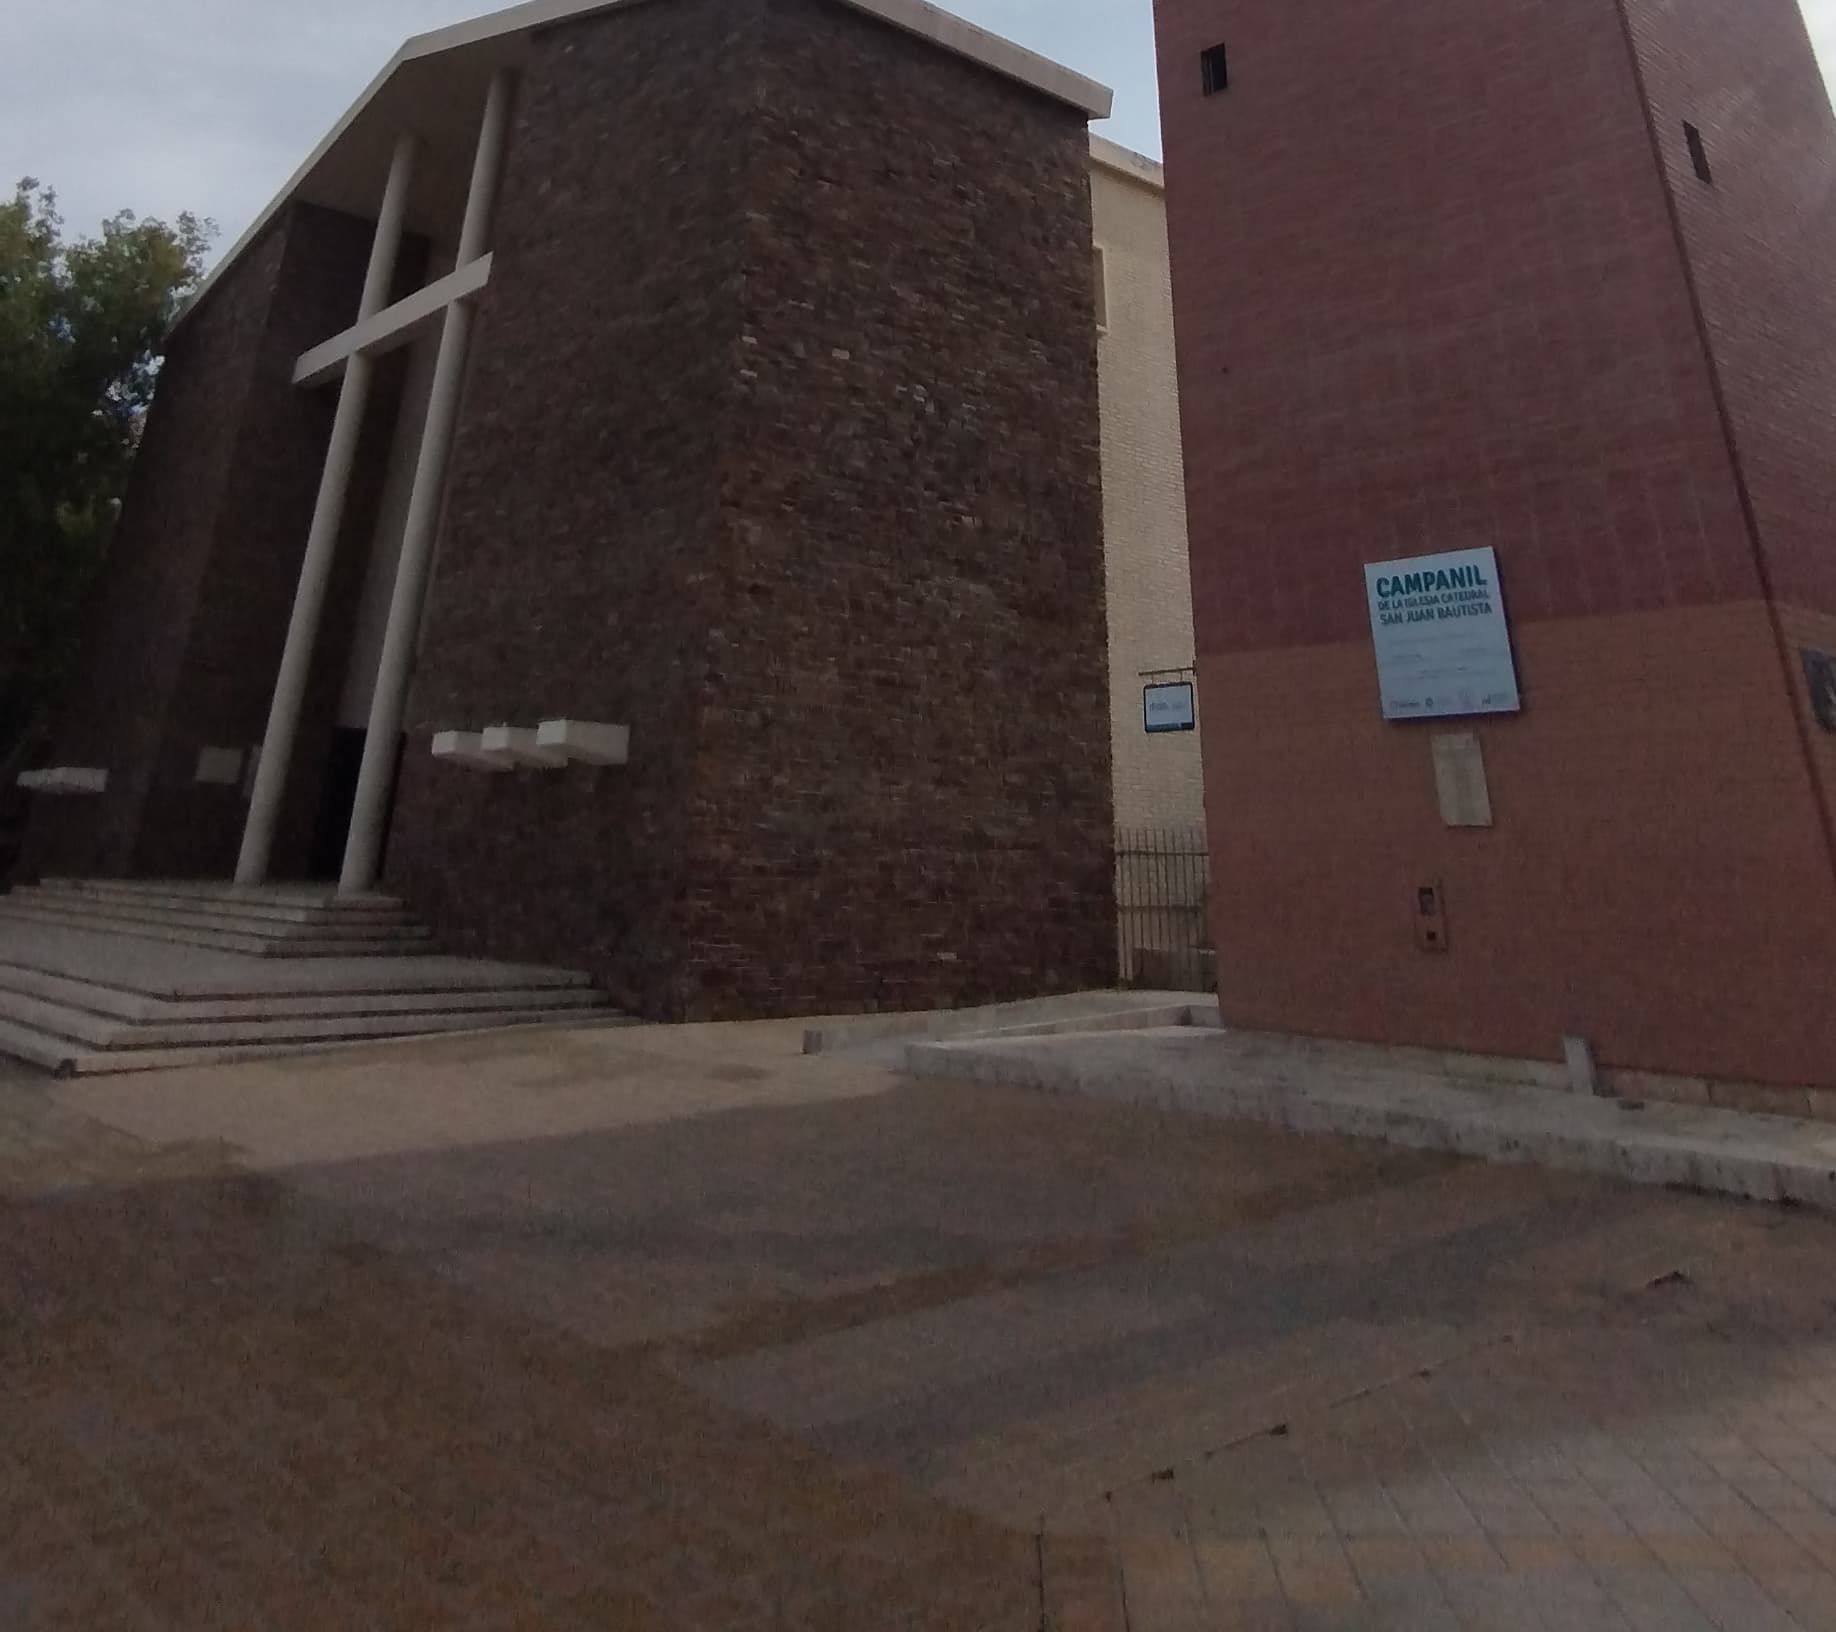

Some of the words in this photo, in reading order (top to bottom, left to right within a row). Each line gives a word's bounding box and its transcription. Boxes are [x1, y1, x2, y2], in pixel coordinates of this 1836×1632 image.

[1376, 564, 1488, 598] CAMPANIL
[1378, 600, 1389, 611] DE
[1392, 598, 1403, 609] LA
[1404, 593, 1440, 608] IGLESIA
[1441, 589, 1490, 604] CATEDRAL
[1380, 611, 1403, 626] SAN
[1406, 608, 1435, 624] JUAN
[1438, 602, 1492, 621] BAUTISTA
